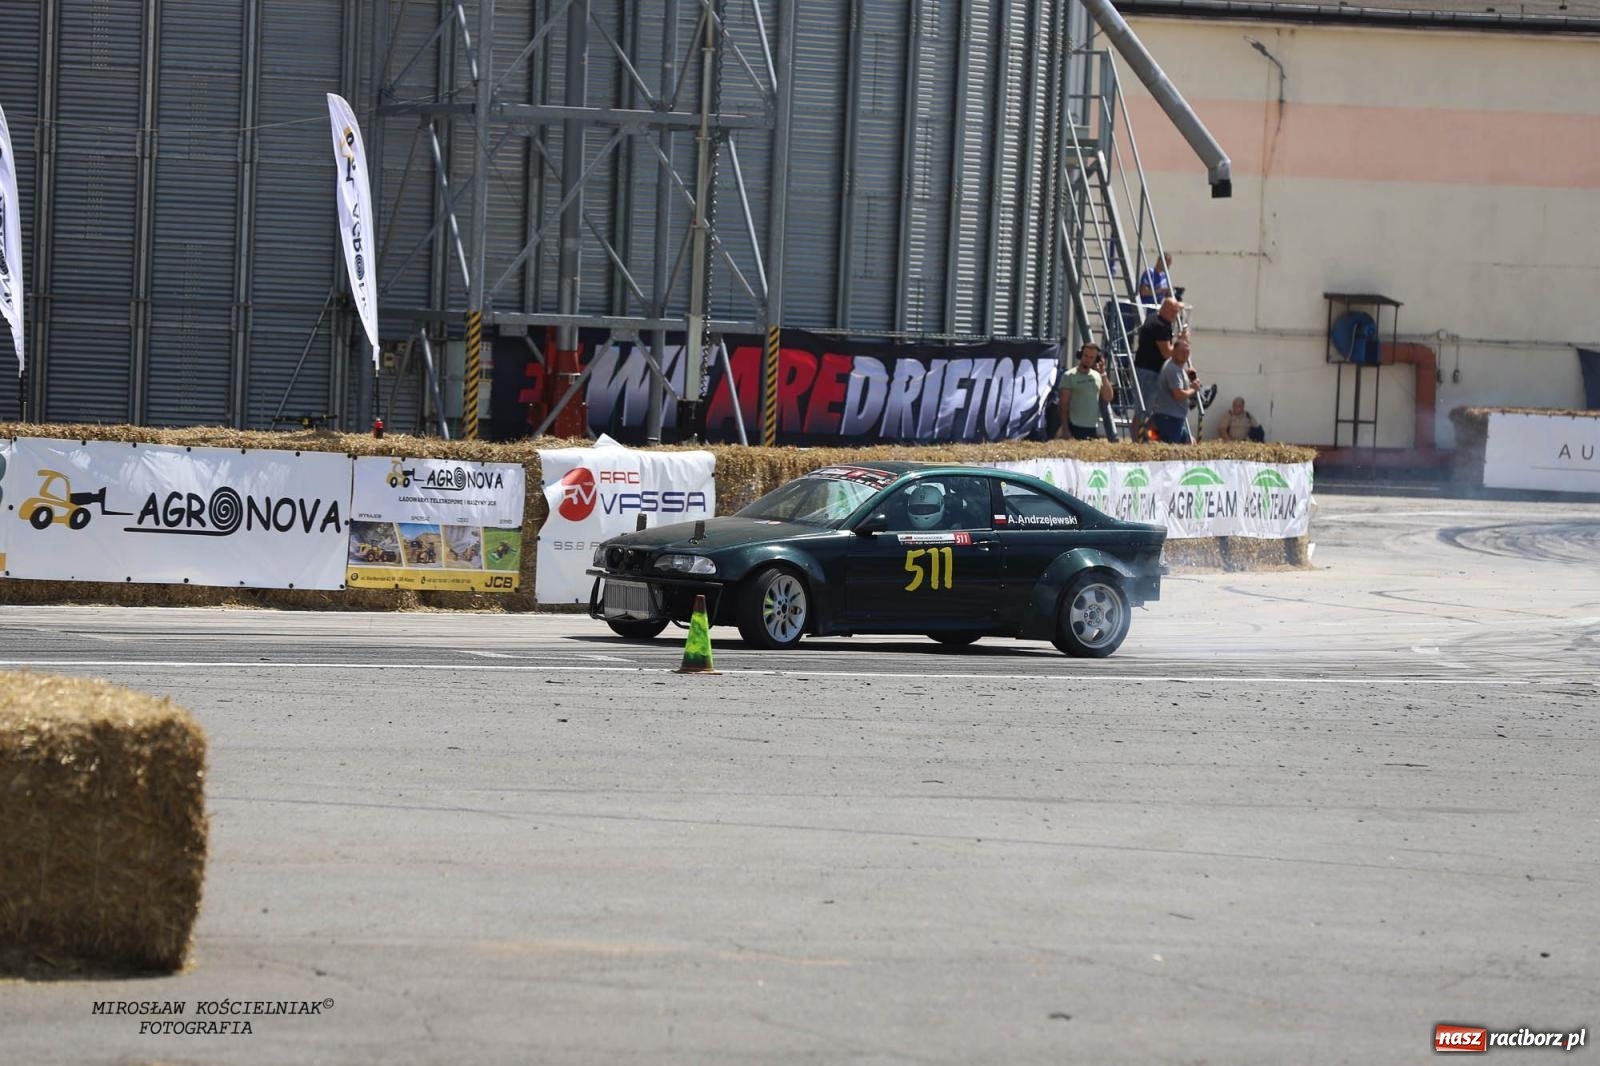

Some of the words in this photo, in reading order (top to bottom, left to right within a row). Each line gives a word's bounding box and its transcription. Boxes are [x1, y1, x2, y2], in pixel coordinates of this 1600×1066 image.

[427, 467, 503, 490] AGRONOVA
[137, 486, 341, 533] AGRONOVA
[956, 534, 968, 544] 511
[904, 546, 953, 592] 511
[484, 576, 513, 588] JCB
